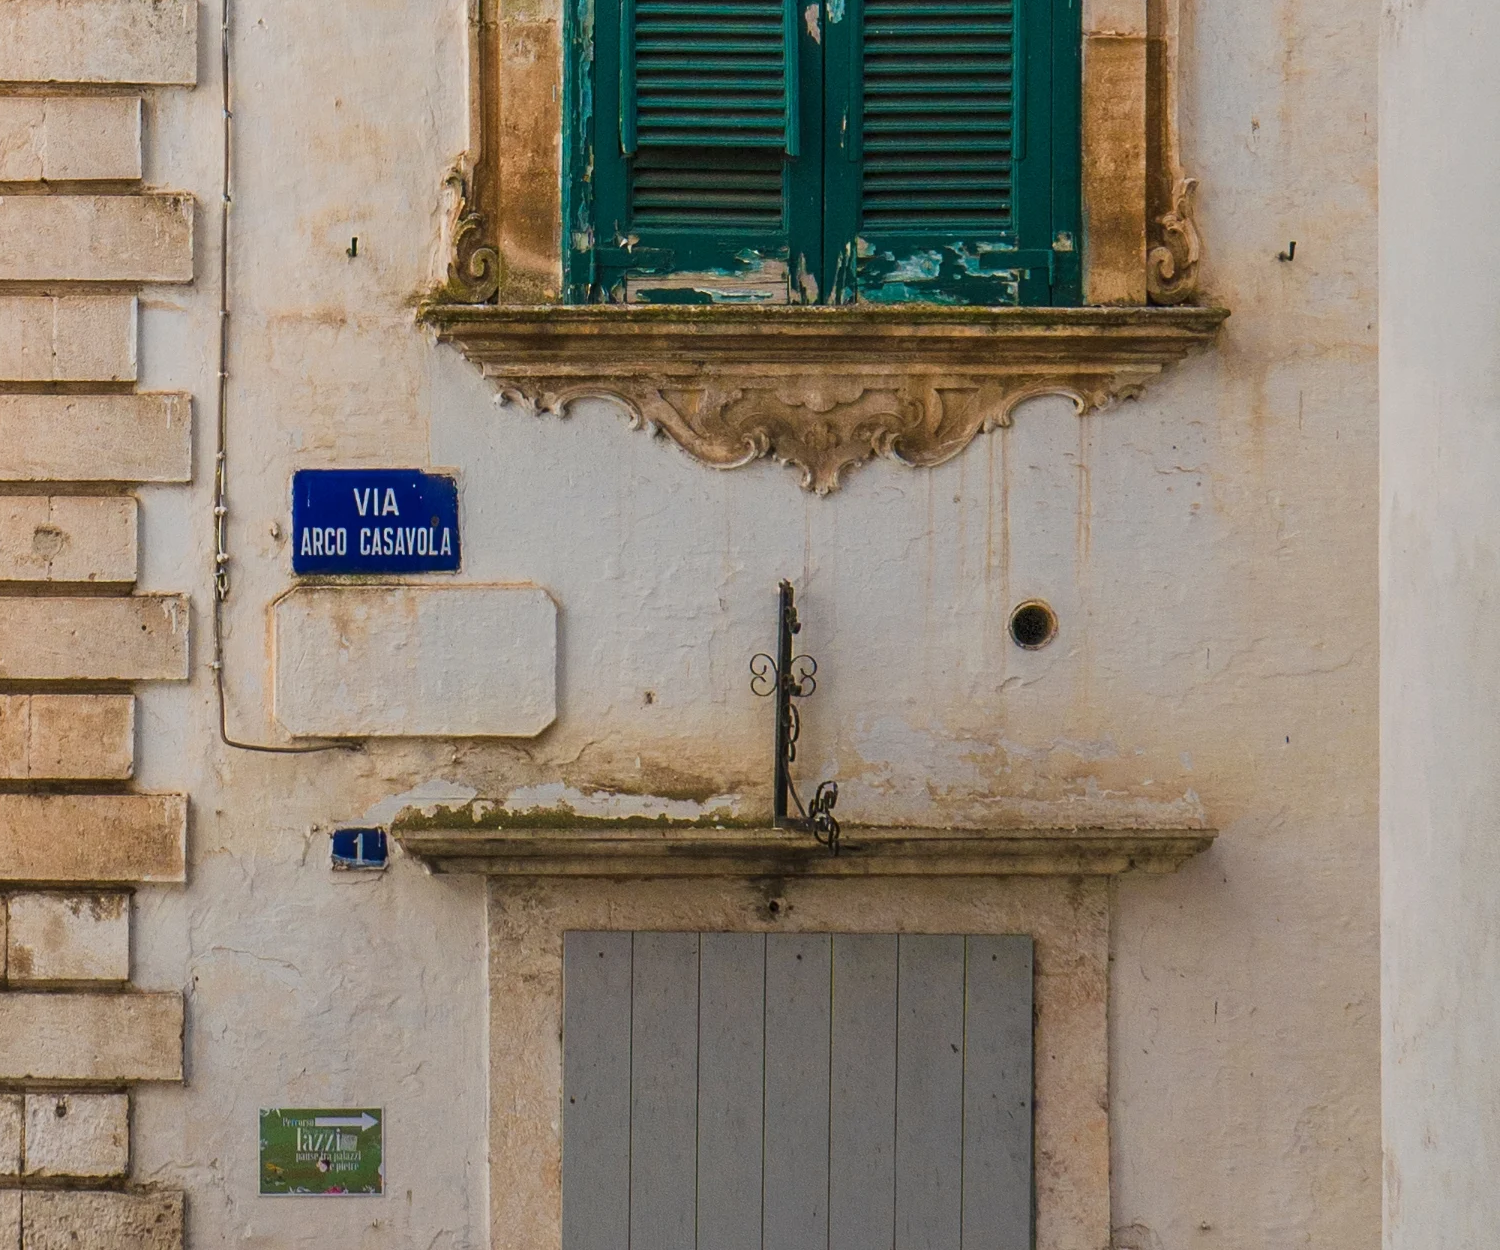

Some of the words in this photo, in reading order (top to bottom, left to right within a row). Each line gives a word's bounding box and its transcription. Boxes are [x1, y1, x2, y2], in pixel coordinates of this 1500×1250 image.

[353, 487, 400, 516] VIA
[301, 527, 347, 556] ARCO
[360, 527, 452, 556] CASAVOLA
[353, 833, 365, 865] 1
[282, 1118, 314, 1127] Percorso
[296, 1152, 319, 1162] pause
[333, 1151, 361, 1162] palazzi
[336, 1162, 359, 1172] pietre
